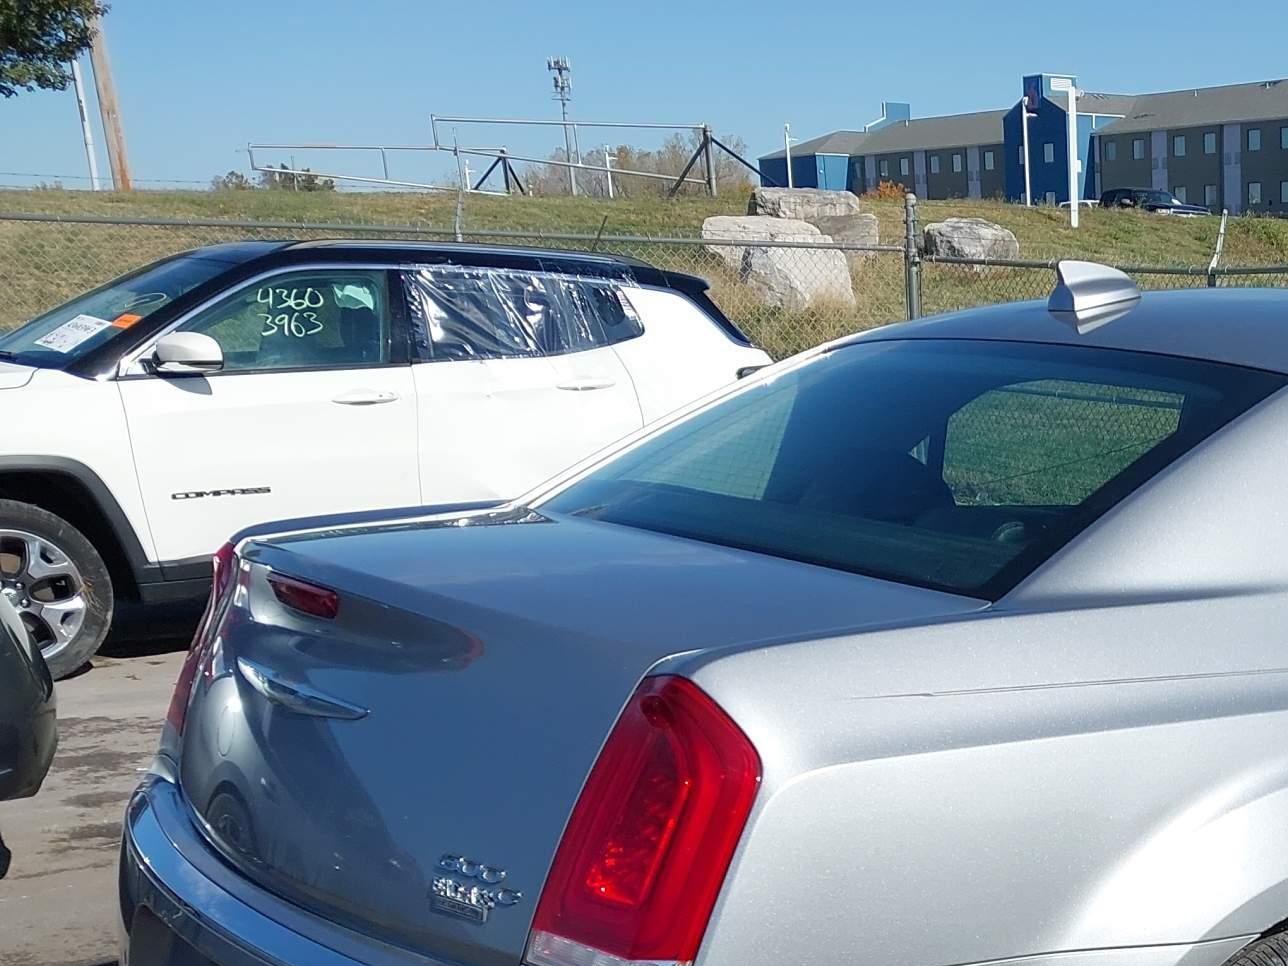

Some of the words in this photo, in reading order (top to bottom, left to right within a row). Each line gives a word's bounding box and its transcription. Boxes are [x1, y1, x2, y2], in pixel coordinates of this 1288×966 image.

[256, 287, 324, 310] 4360
[257, 311, 324, 338] 3963
[171, 486, 272, 500] COMPASS
